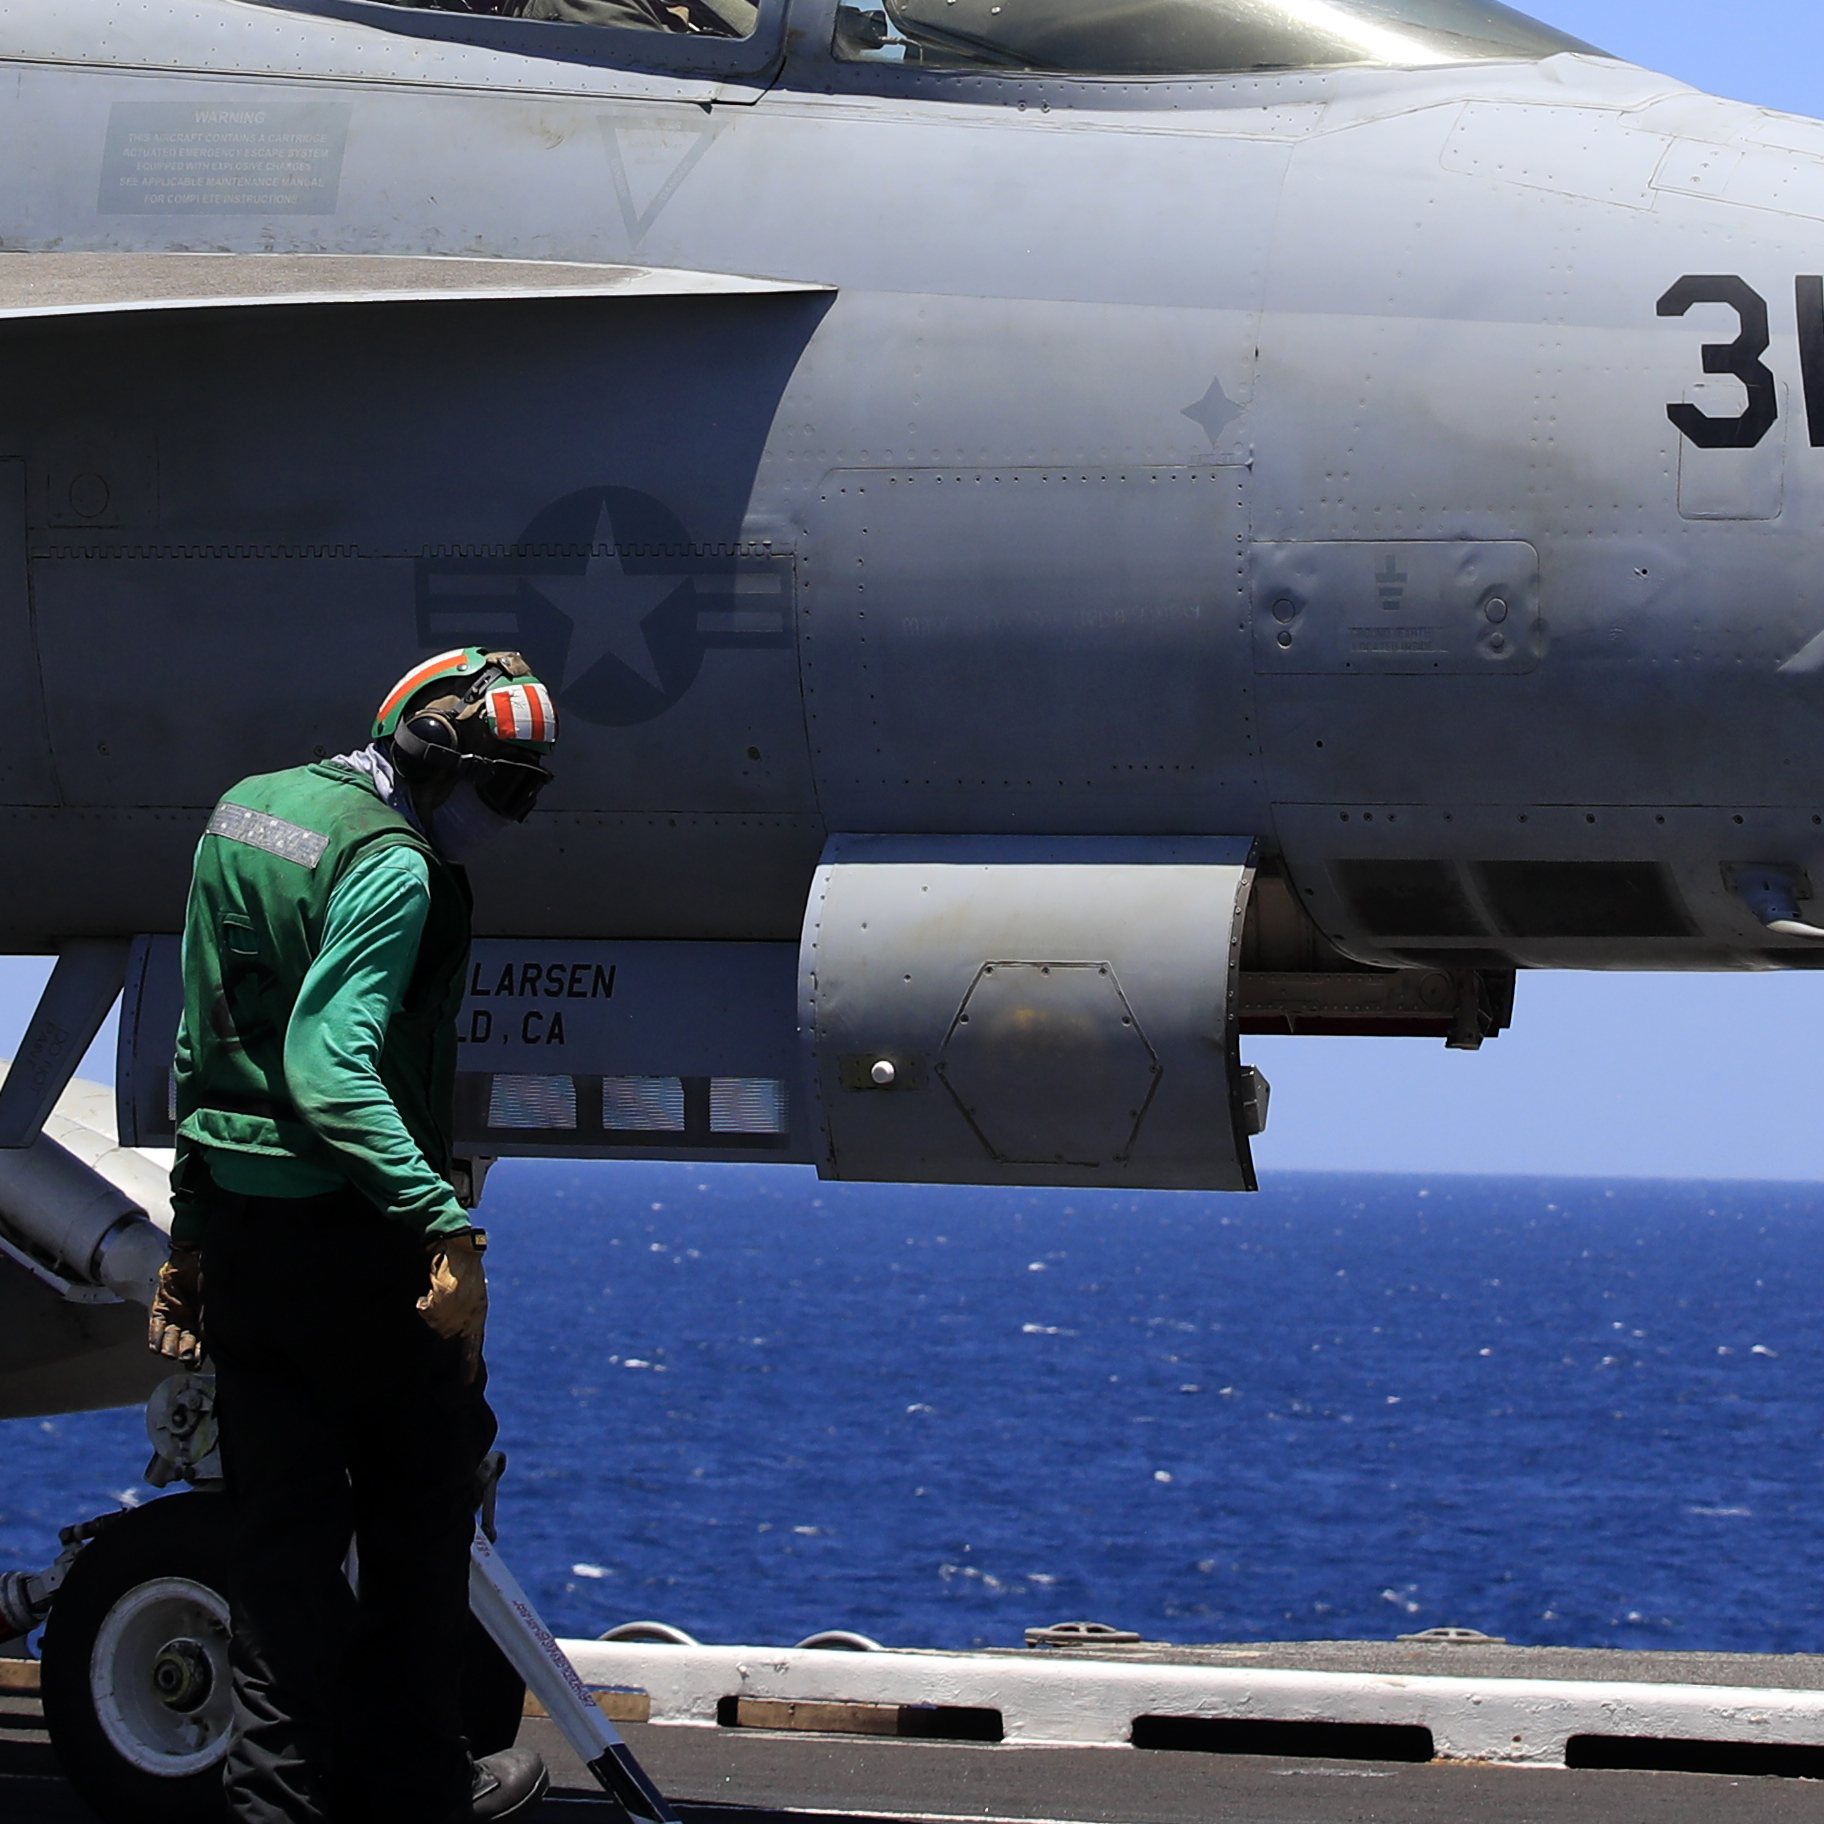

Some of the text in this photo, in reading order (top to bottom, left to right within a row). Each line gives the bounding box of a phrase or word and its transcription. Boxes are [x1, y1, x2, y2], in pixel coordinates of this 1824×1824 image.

[194, 110, 267, 124] WARNING
[128, 133, 327, 144] THIS AIRCRAFT CONTAINS A CARTRIDGE
[122, 148, 329, 158] ACTUATED EMERGENCY ESCAPE SYSTEM
[186, 161, 210, 172] WITH
[212, 161, 264, 172] EXPLOSIVE
[265, 161, 312, 172] CHARGES
[119, 177, 325, 188] SEE APPLICABLE MAINTENANCE MANUAL
[144, 194, 299, 205] FOR COMPLETE INSTRUCTIONS
[470, 963, 617, 998] LARSEN
[522, 1011, 566, 1044] CA
